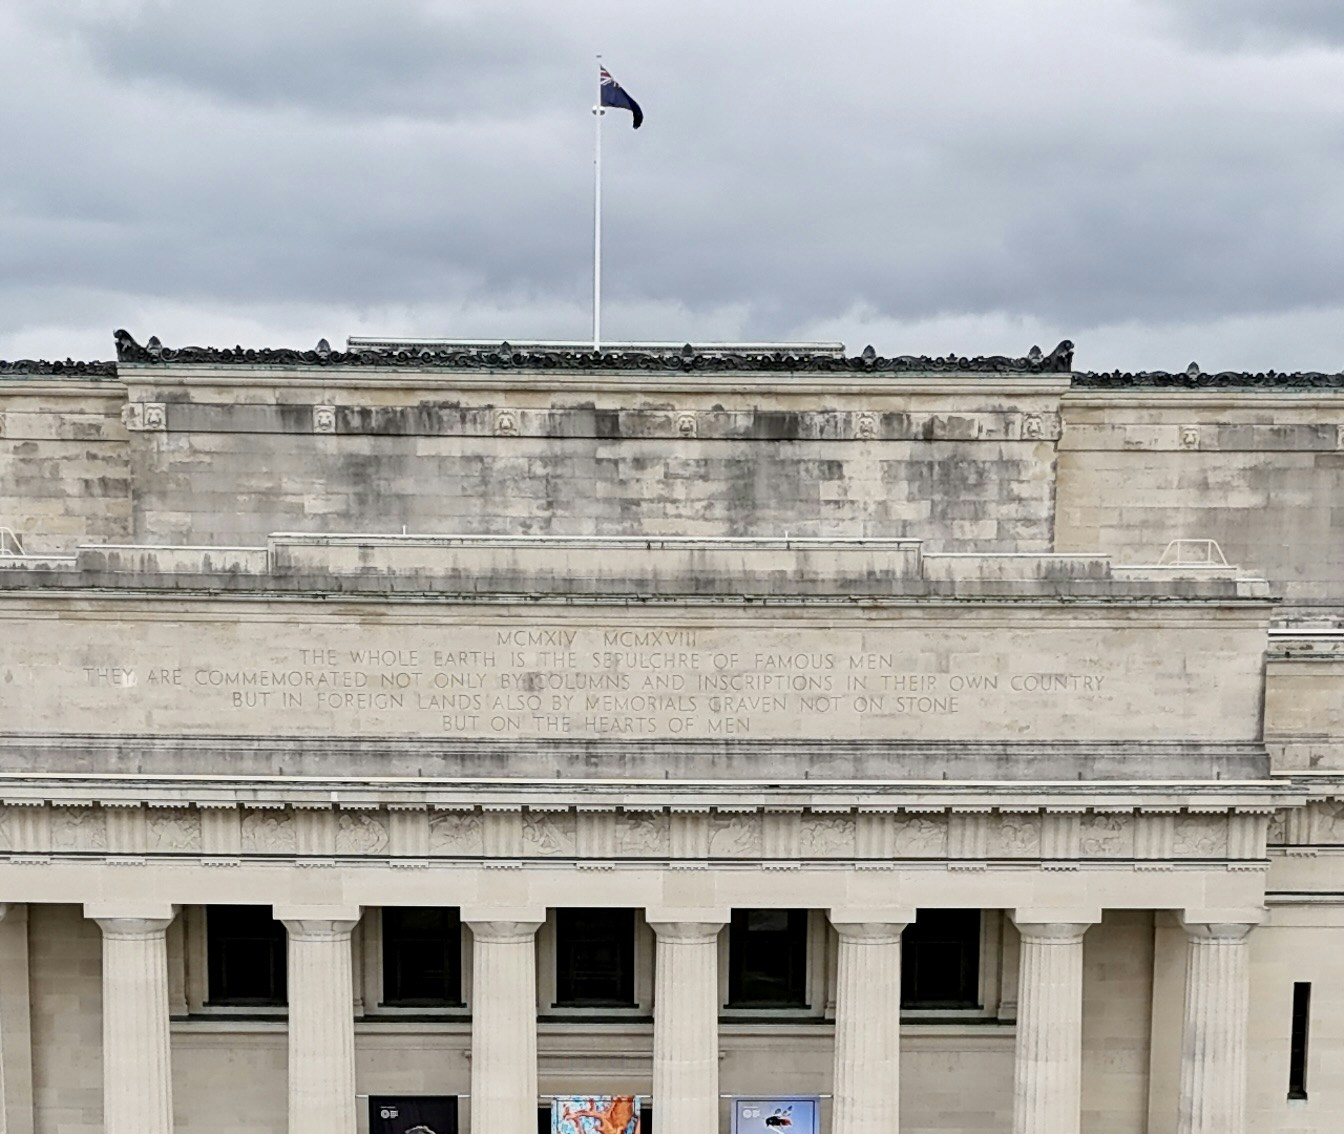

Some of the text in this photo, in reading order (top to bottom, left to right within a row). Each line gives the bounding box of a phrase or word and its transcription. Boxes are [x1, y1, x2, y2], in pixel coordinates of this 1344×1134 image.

[496, 630, 697, 648] MCMXIV MCMXVIII
[298, 649, 894, 670] THE WHOLE EARTH IS THE SEPULCHRE OF FAMOUS MEN
[82, 667, 1105, 692] THEY ARE COMMEMORATED NOT ONLY BY COLUMNS AND INSCRIPTIONS IN THEIR OWN COUNTRY
[232, 691, 959, 713] BUT IN FOREIGN LANDS ALSO BY MEMORIALS GRAVEN NOT ON STONE
[442, 714, 751, 734] BUT ON THE HEARTS OF MEN
